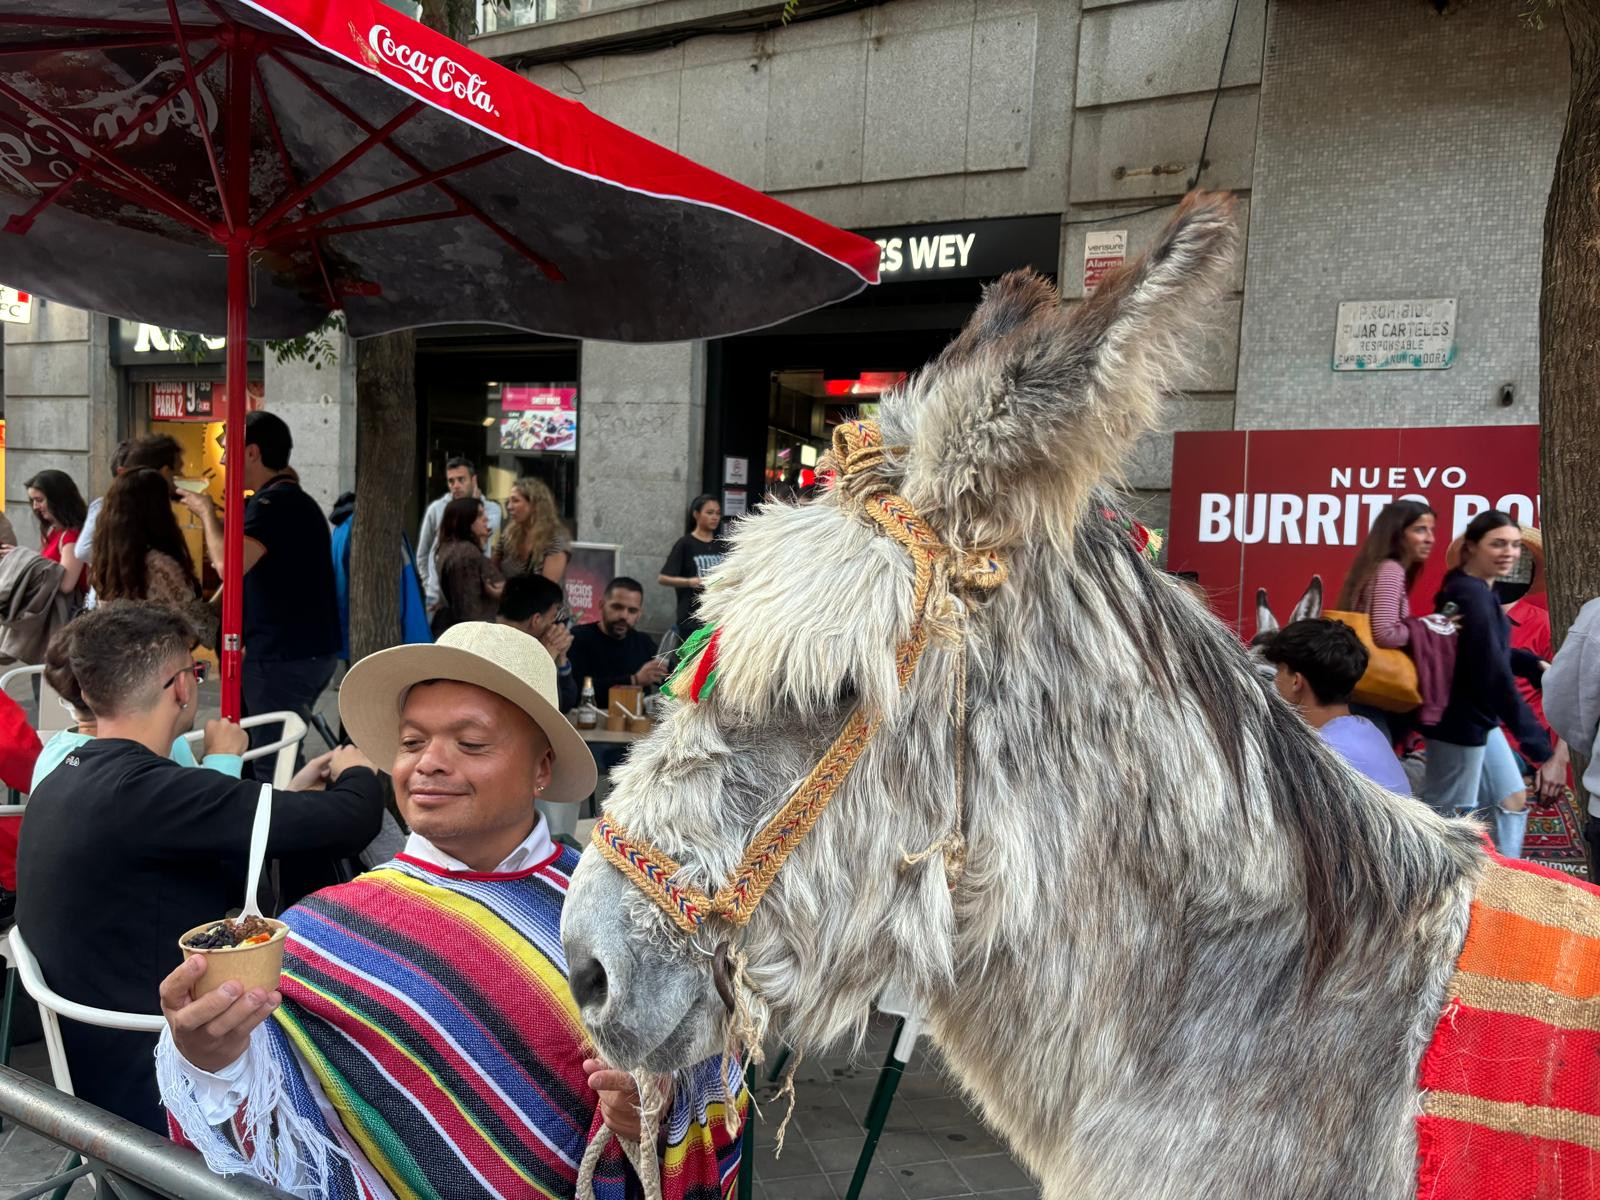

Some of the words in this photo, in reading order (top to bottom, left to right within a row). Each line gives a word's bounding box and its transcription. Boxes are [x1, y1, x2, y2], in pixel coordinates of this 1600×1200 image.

[368, 24, 494, 113] Coca-Cola
[909, 232, 976, 269] WEY
[1382, 321, 1449, 337] CARTELES
[1360, 339, 1424, 351] RESPONSABLE
[155, 395, 176, 416] PARA
[177, 395, 183, 416] 2
[1331, 466, 1467, 489] NUEVO
[1199, 492, 1430, 546] BURRIT
